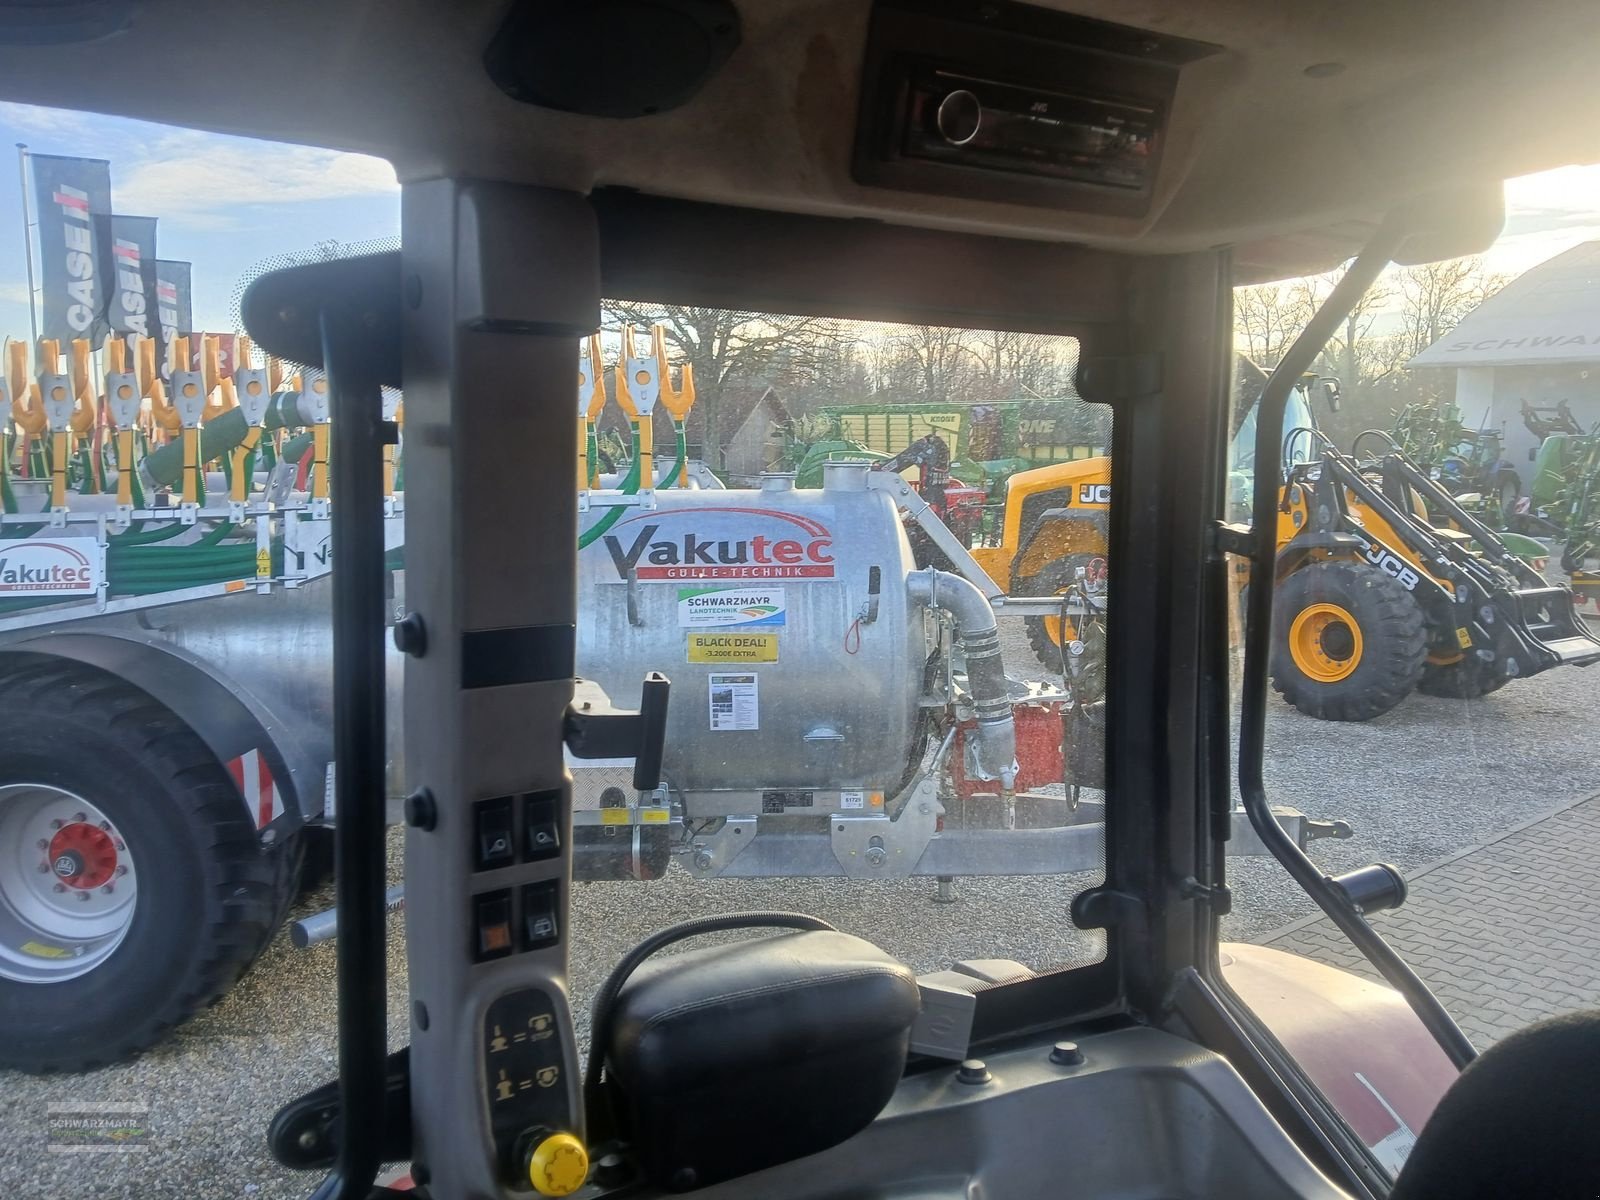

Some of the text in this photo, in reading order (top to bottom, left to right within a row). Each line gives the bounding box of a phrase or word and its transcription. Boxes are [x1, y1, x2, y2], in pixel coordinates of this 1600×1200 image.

[1030, 101, 1048, 112] JVC
[65, 224, 94, 331] CASE
[1018, 419, 1057, 433] ONE
[1080, 485, 1111, 502] JC
[603, 525, 835, 579] Vakutec
[0, 558, 91, 583] akutec
[1366, 549, 1420, 591] JCB
[687, 596, 771, 607] SCHWARZMAYR
[689, 607, 738, 615] LANDTECHNIK
[695, 637, 767, 648] BLACK DEAL!
